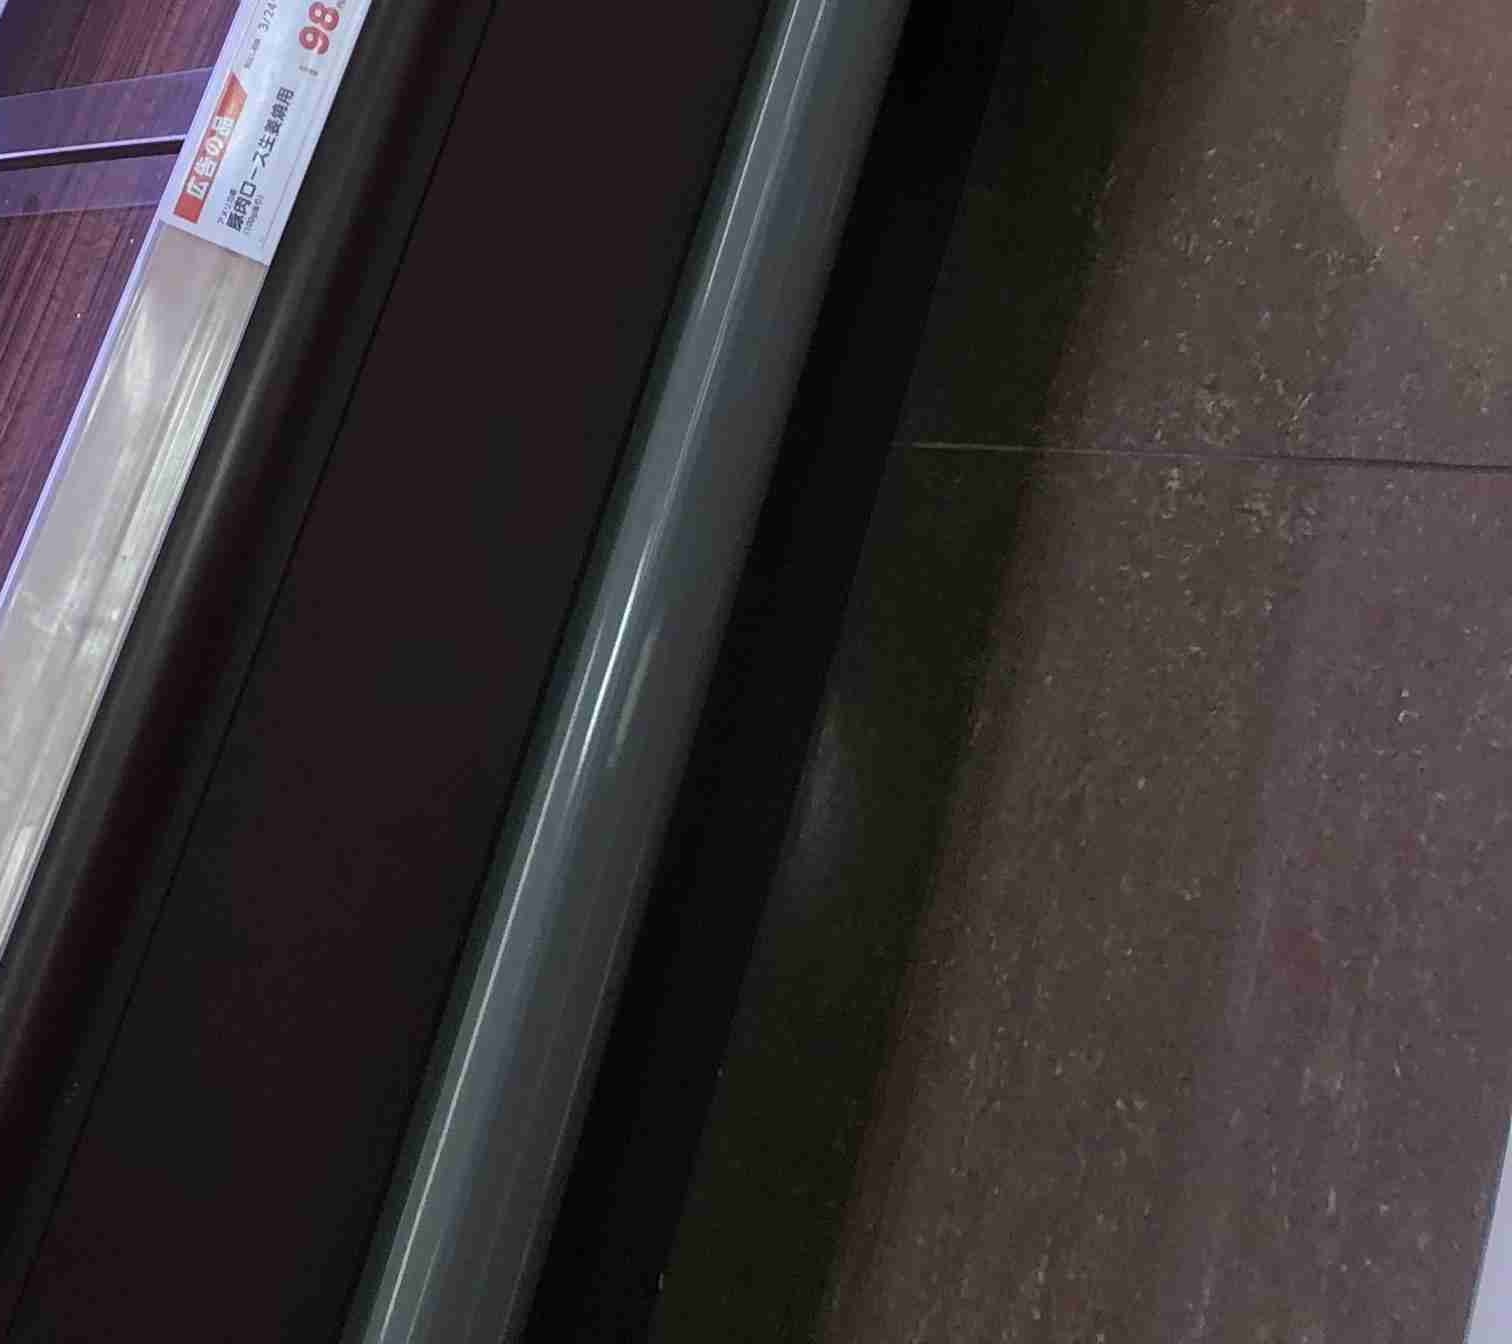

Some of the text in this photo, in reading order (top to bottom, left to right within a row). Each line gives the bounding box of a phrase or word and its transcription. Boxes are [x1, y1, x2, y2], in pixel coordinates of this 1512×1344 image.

[187, 112, 235, 198] 広告の品
[225, 85, 295, 231] 豚肉ロース生姜焼用
